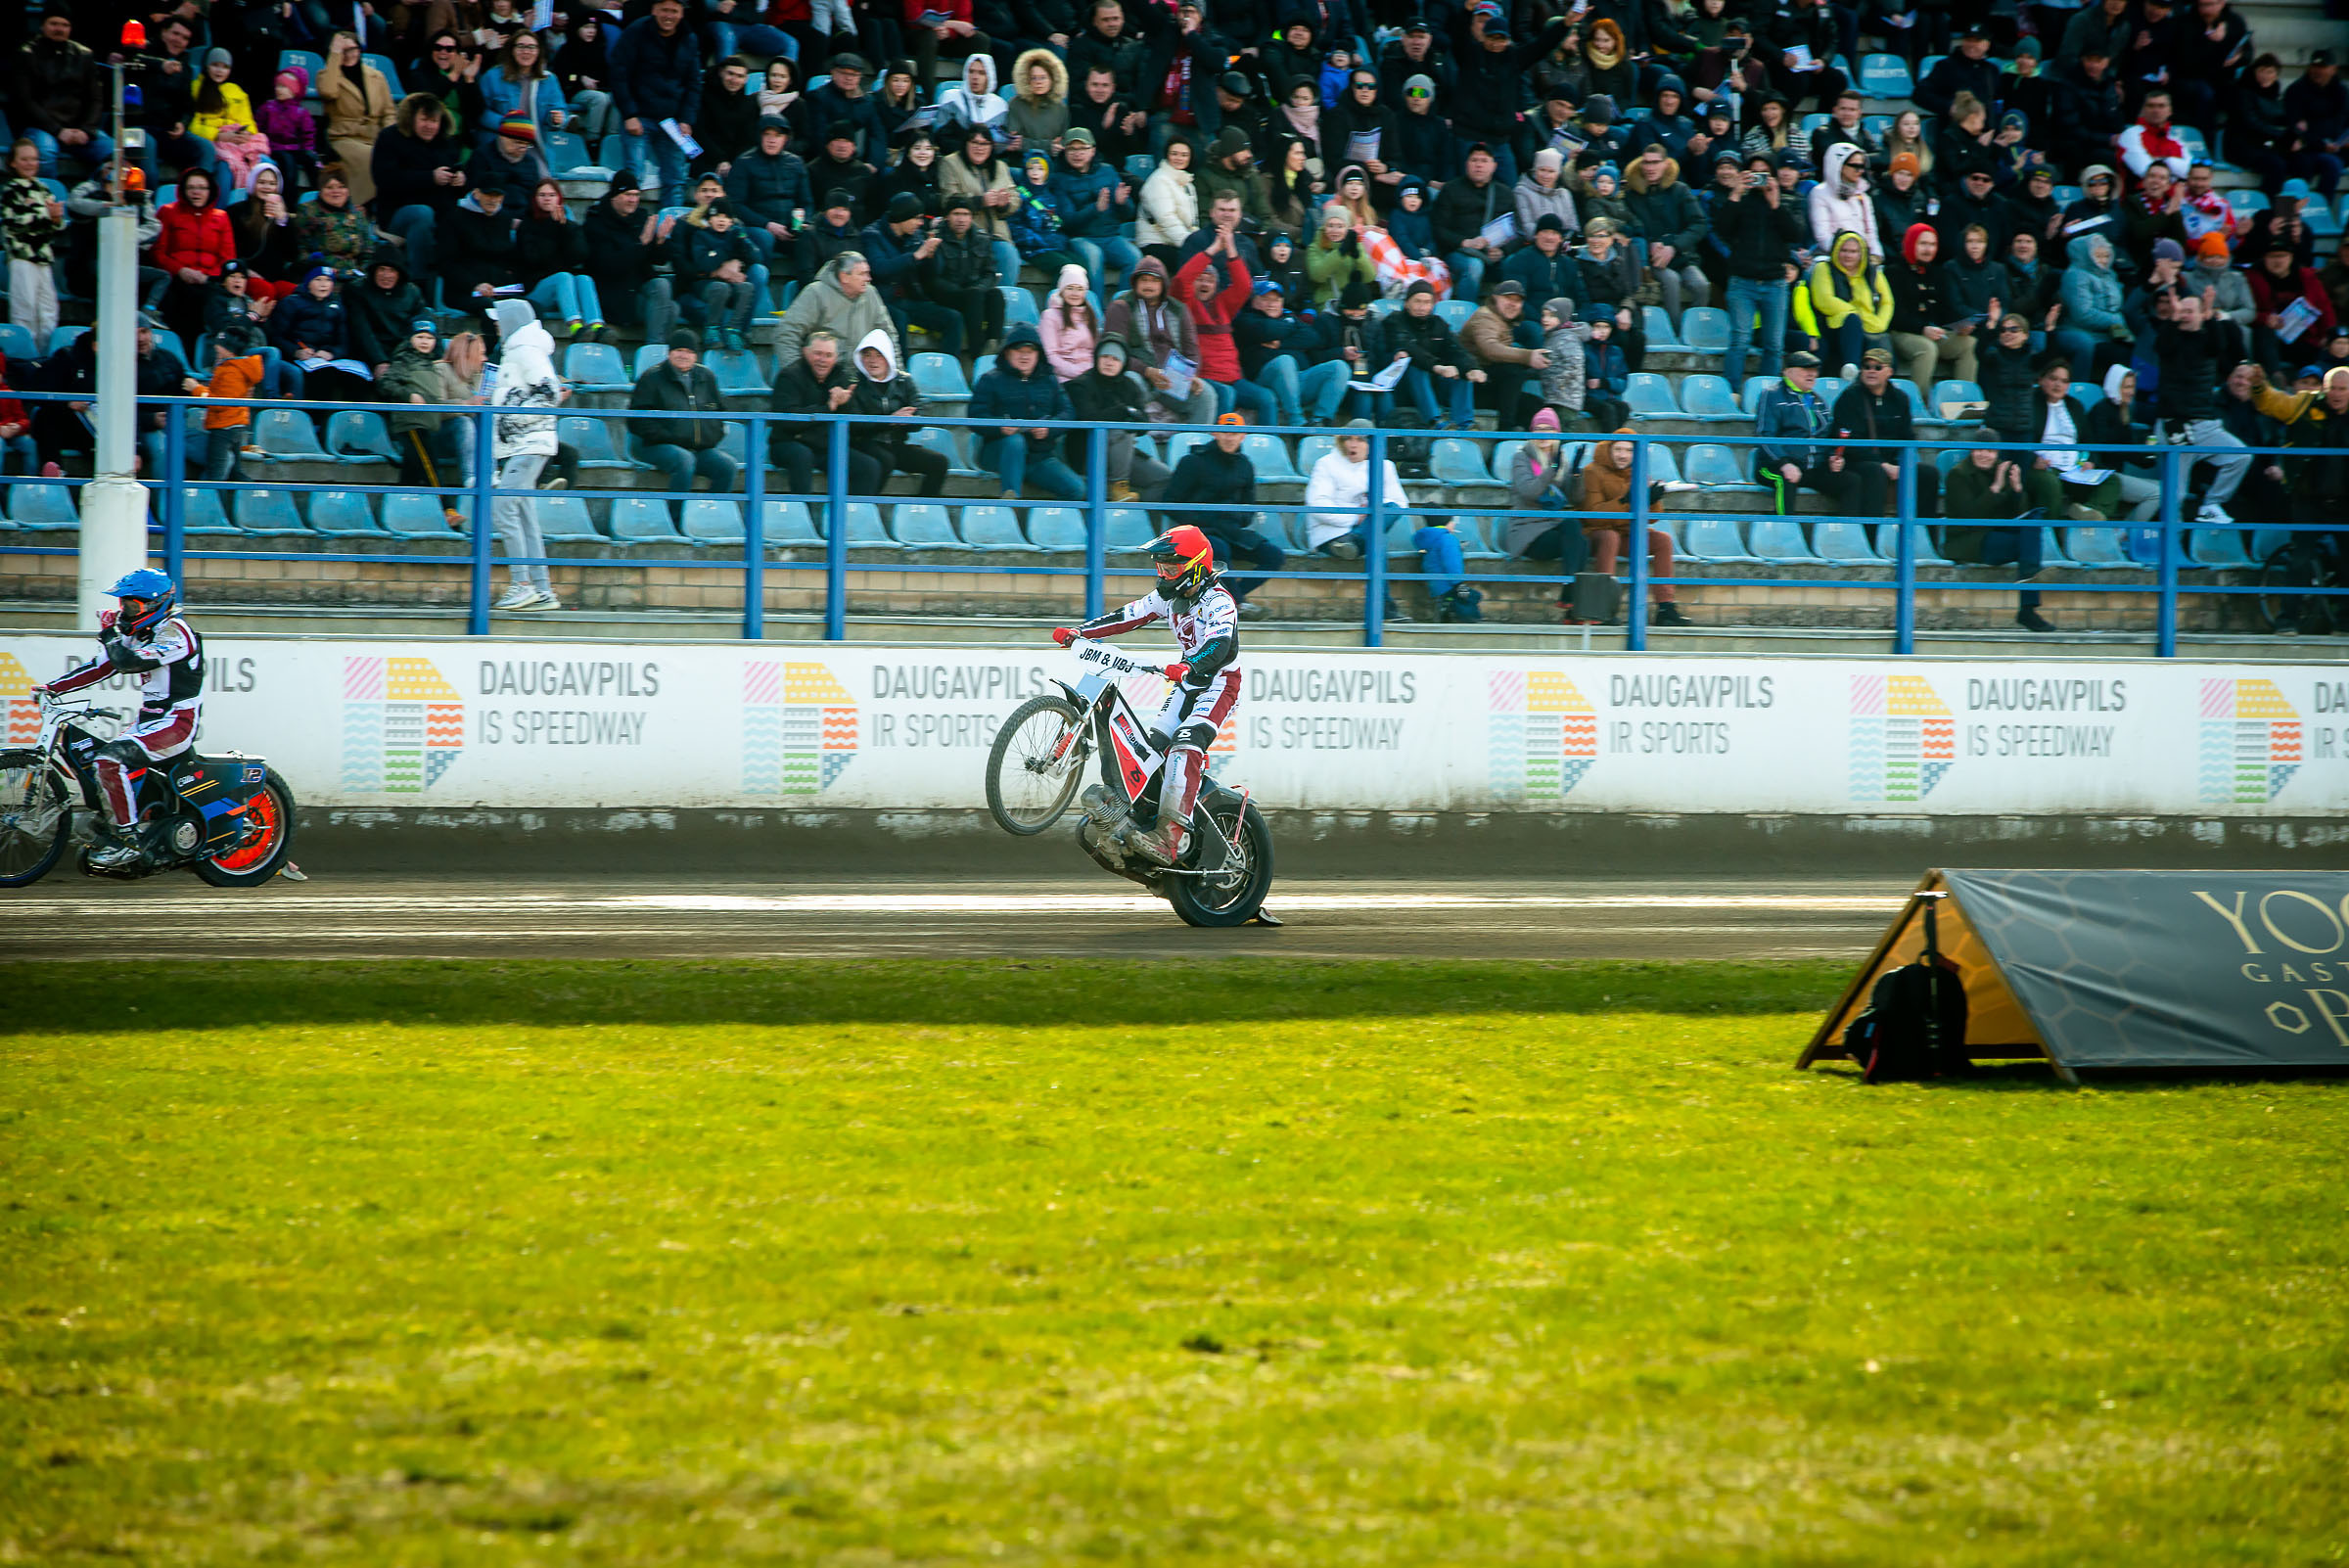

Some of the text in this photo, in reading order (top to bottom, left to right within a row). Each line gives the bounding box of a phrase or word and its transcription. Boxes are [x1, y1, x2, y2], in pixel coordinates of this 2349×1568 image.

[1079, 648, 1102, 663] JBM
[1101, 654, 1111, 667] &
[479, 661, 661, 697] DAUGAVPILS
[872, 665, 1044, 700] DAUGAVPILS
[1250, 669, 1415, 704] DAUGAVPILS
[1610, 674, 1773, 708] DAUGAVPILS
[1967, 678, 2126, 712] DAUGAVPILS
[478, 710, 647, 745] IS SPEEDWAY
[872, 714, 999, 748] IR SPORTS
[1249, 716, 1405, 750] IS SPEEDWAY
[1610, 721, 1730, 754] IR SPORTS
[1966, 724, 2115, 757] IS SPEEDWAY
[2314, 727, 2336, 759] IR
[2190, 890, 2349, 954] YO
